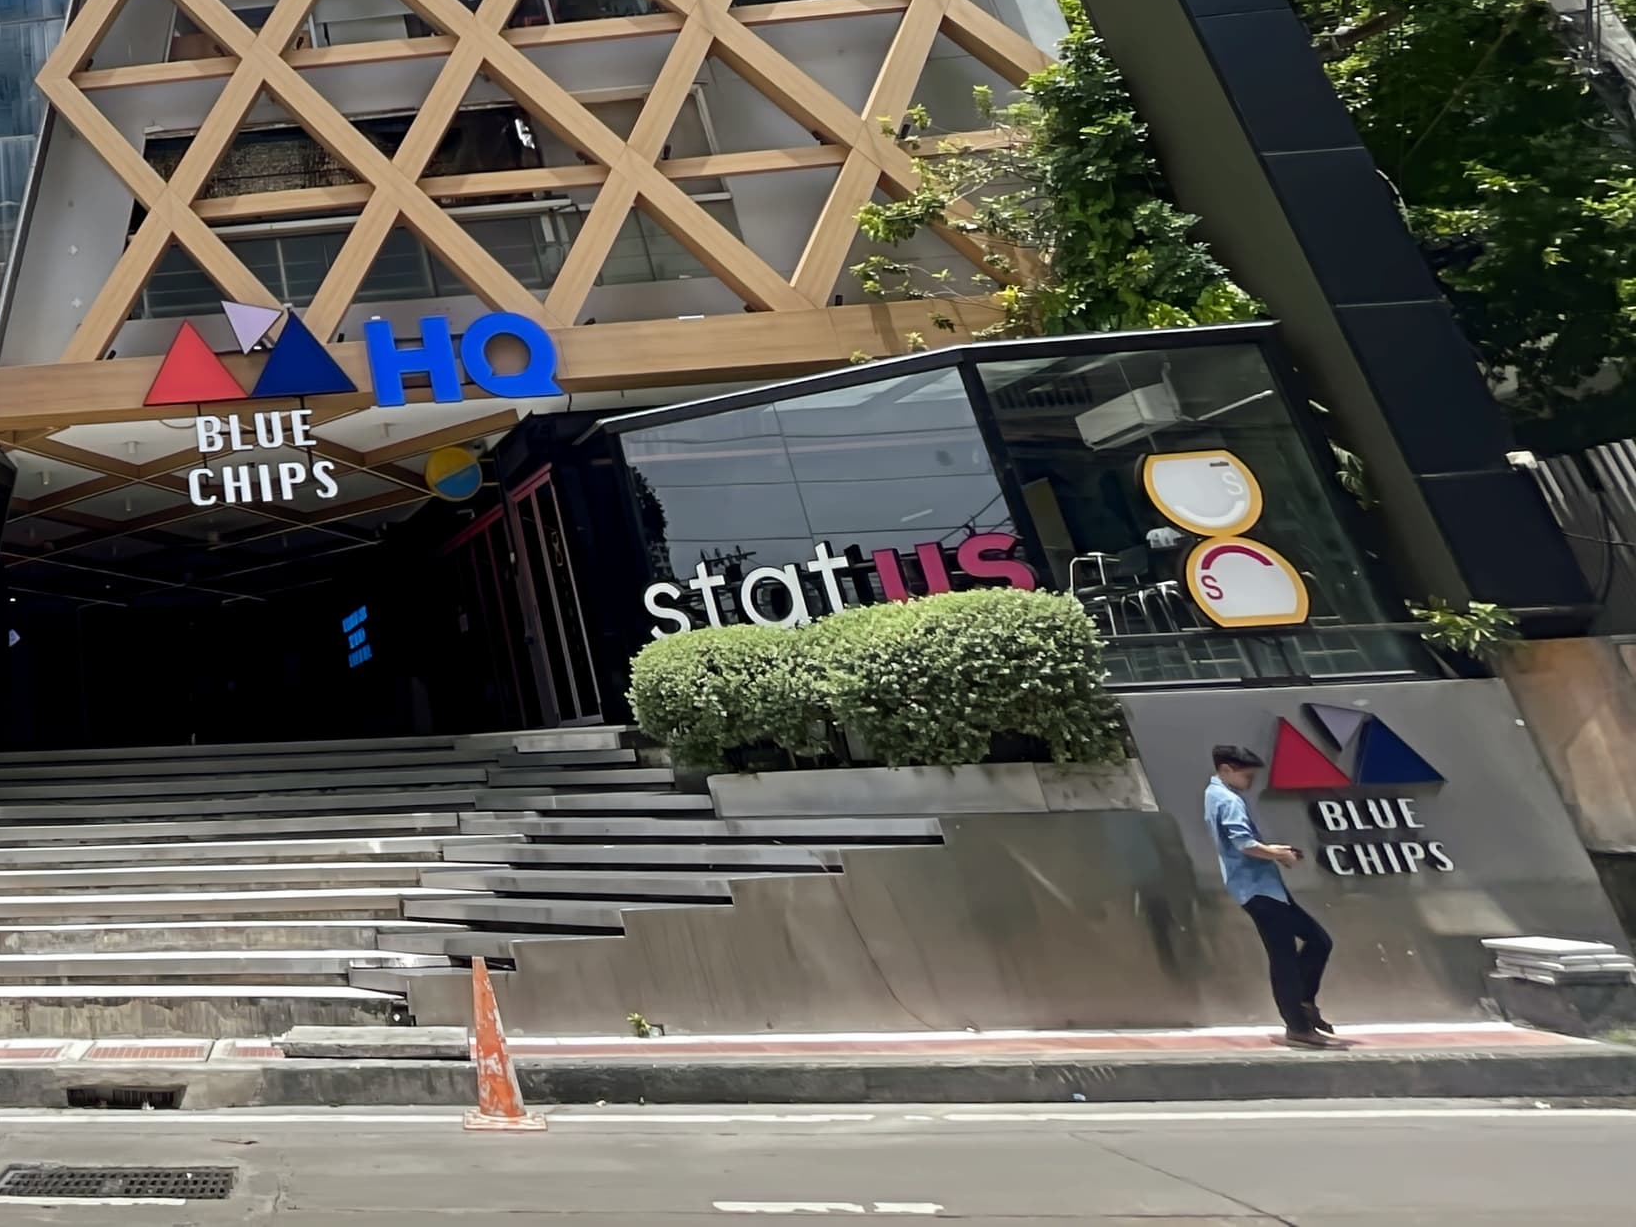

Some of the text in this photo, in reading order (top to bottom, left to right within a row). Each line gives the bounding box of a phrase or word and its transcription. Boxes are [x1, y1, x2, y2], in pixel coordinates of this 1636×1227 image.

[364, 311, 564, 407] HQ
[196, 409, 317, 454] BLUE
[188, 460, 339, 507] CHIPS
[643, 533, 1036, 640] status
[1317, 798, 1425, 832] BLUE
[1326, 840, 1455, 876] CHIPS
